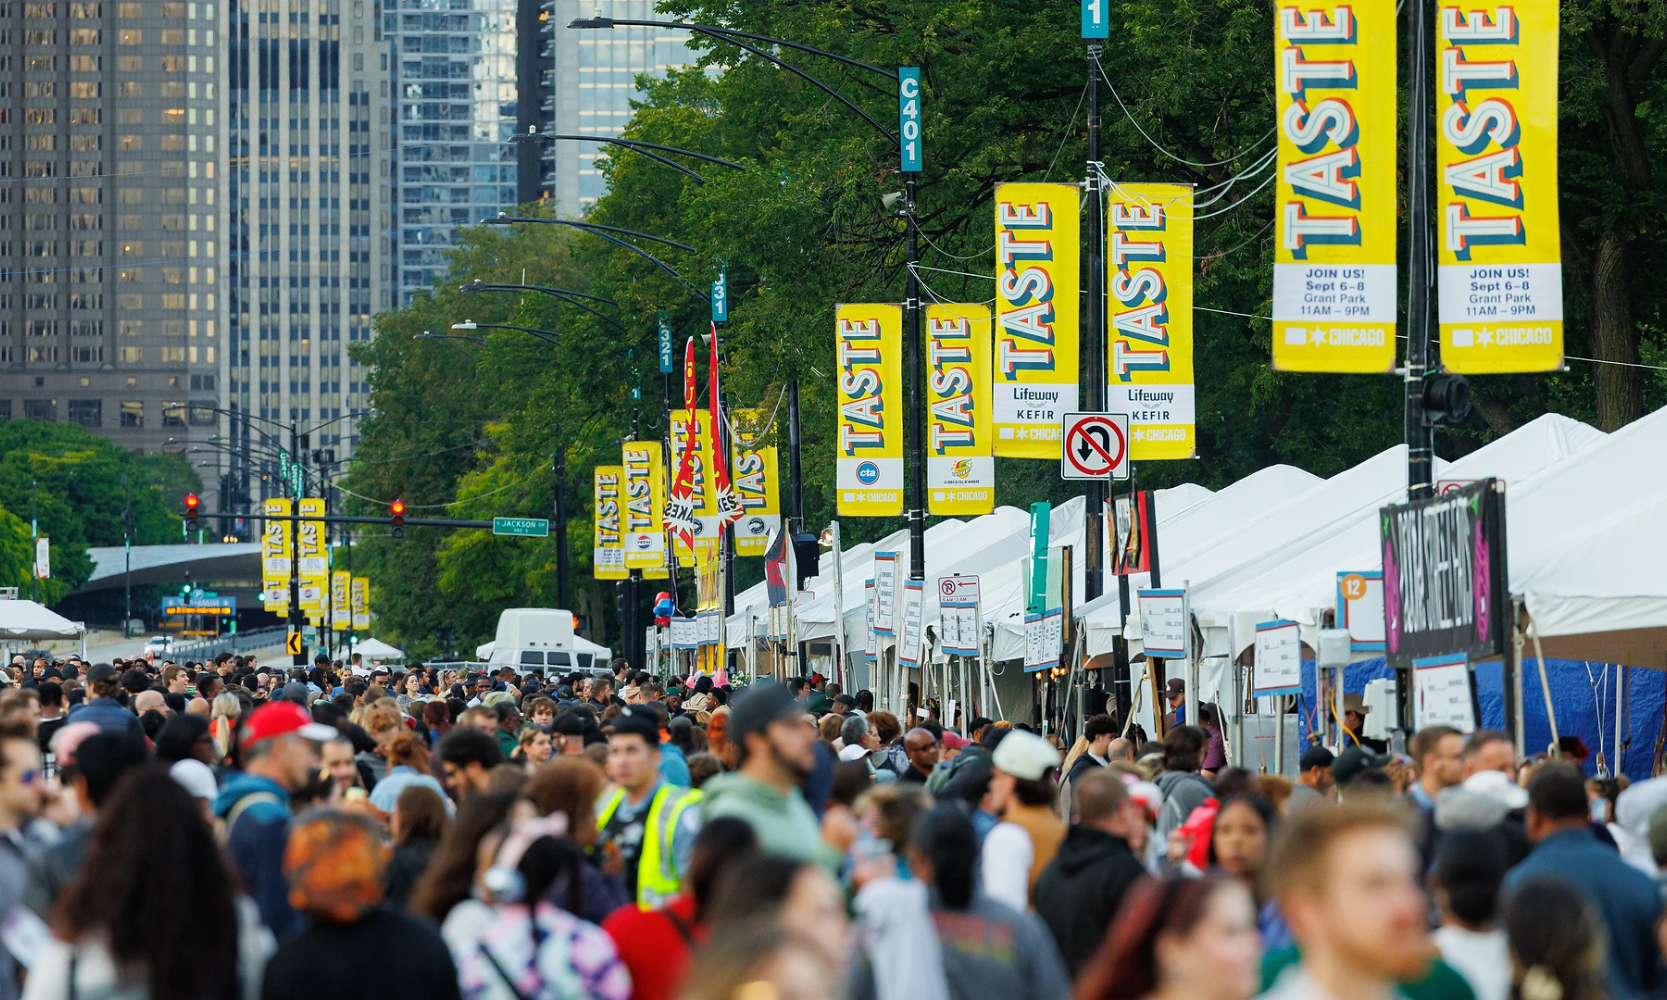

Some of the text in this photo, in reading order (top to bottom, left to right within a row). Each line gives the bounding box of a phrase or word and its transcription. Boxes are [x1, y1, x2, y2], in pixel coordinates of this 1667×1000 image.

[901, 78, 918, 161] C401
[1281, 4, 1362, 260] TASTE
[1442, 4, 1526, 261] TASTE
[1306, 268, 1365, 279] JOIN US!
[1470, 268, 1529, 279] JOIN US!
[1000, 201, 1055, 381] TASTE
[1112, 202, 1170, 382] TASTE
[1305, 281, 1335, 292] Sept
[1470, 281, 1500, 292] Sept
[1304, 293, 1366, 303] Grant Park
[1469, 293, 1531, 303] Grant Park
[1301, 305, 1332, 315] 11AM
[1345, 306, 1370, 315] 9PM
[1466, 306, 1497, 316] 11AM
[1510, 305, 1536, 315] 9PM
[1328, 327, 1385, 347] CHICAGO
[1496, 327, 1553, 346] CHICAGO
[839, 317, 885, 456] TASTE
[929, 316, 976, 455] TASTE
[1014, 387, 1059, 403] Lifeway
[1128, 389, 1174, 404] Lifeway
[1017, 410, 1054, 420] KEFIR
[1132, 411, 1170, 421] KEFIR
[1029, 428, 1062, 440] CHICAG
[1146, 429, 1186, 441] CHICAGO
[860, 469, 876, 477] cta
[624, 449, 653, 532] TASTE
[957, 490, 988, 501] CHICAGO
[866, 492, 897, 503] CHICAGO
[596, 473, 620, 547] TASTE
[502, 520, 536, 528] JACKSON
[1346, 578, 1361, 596] 12
